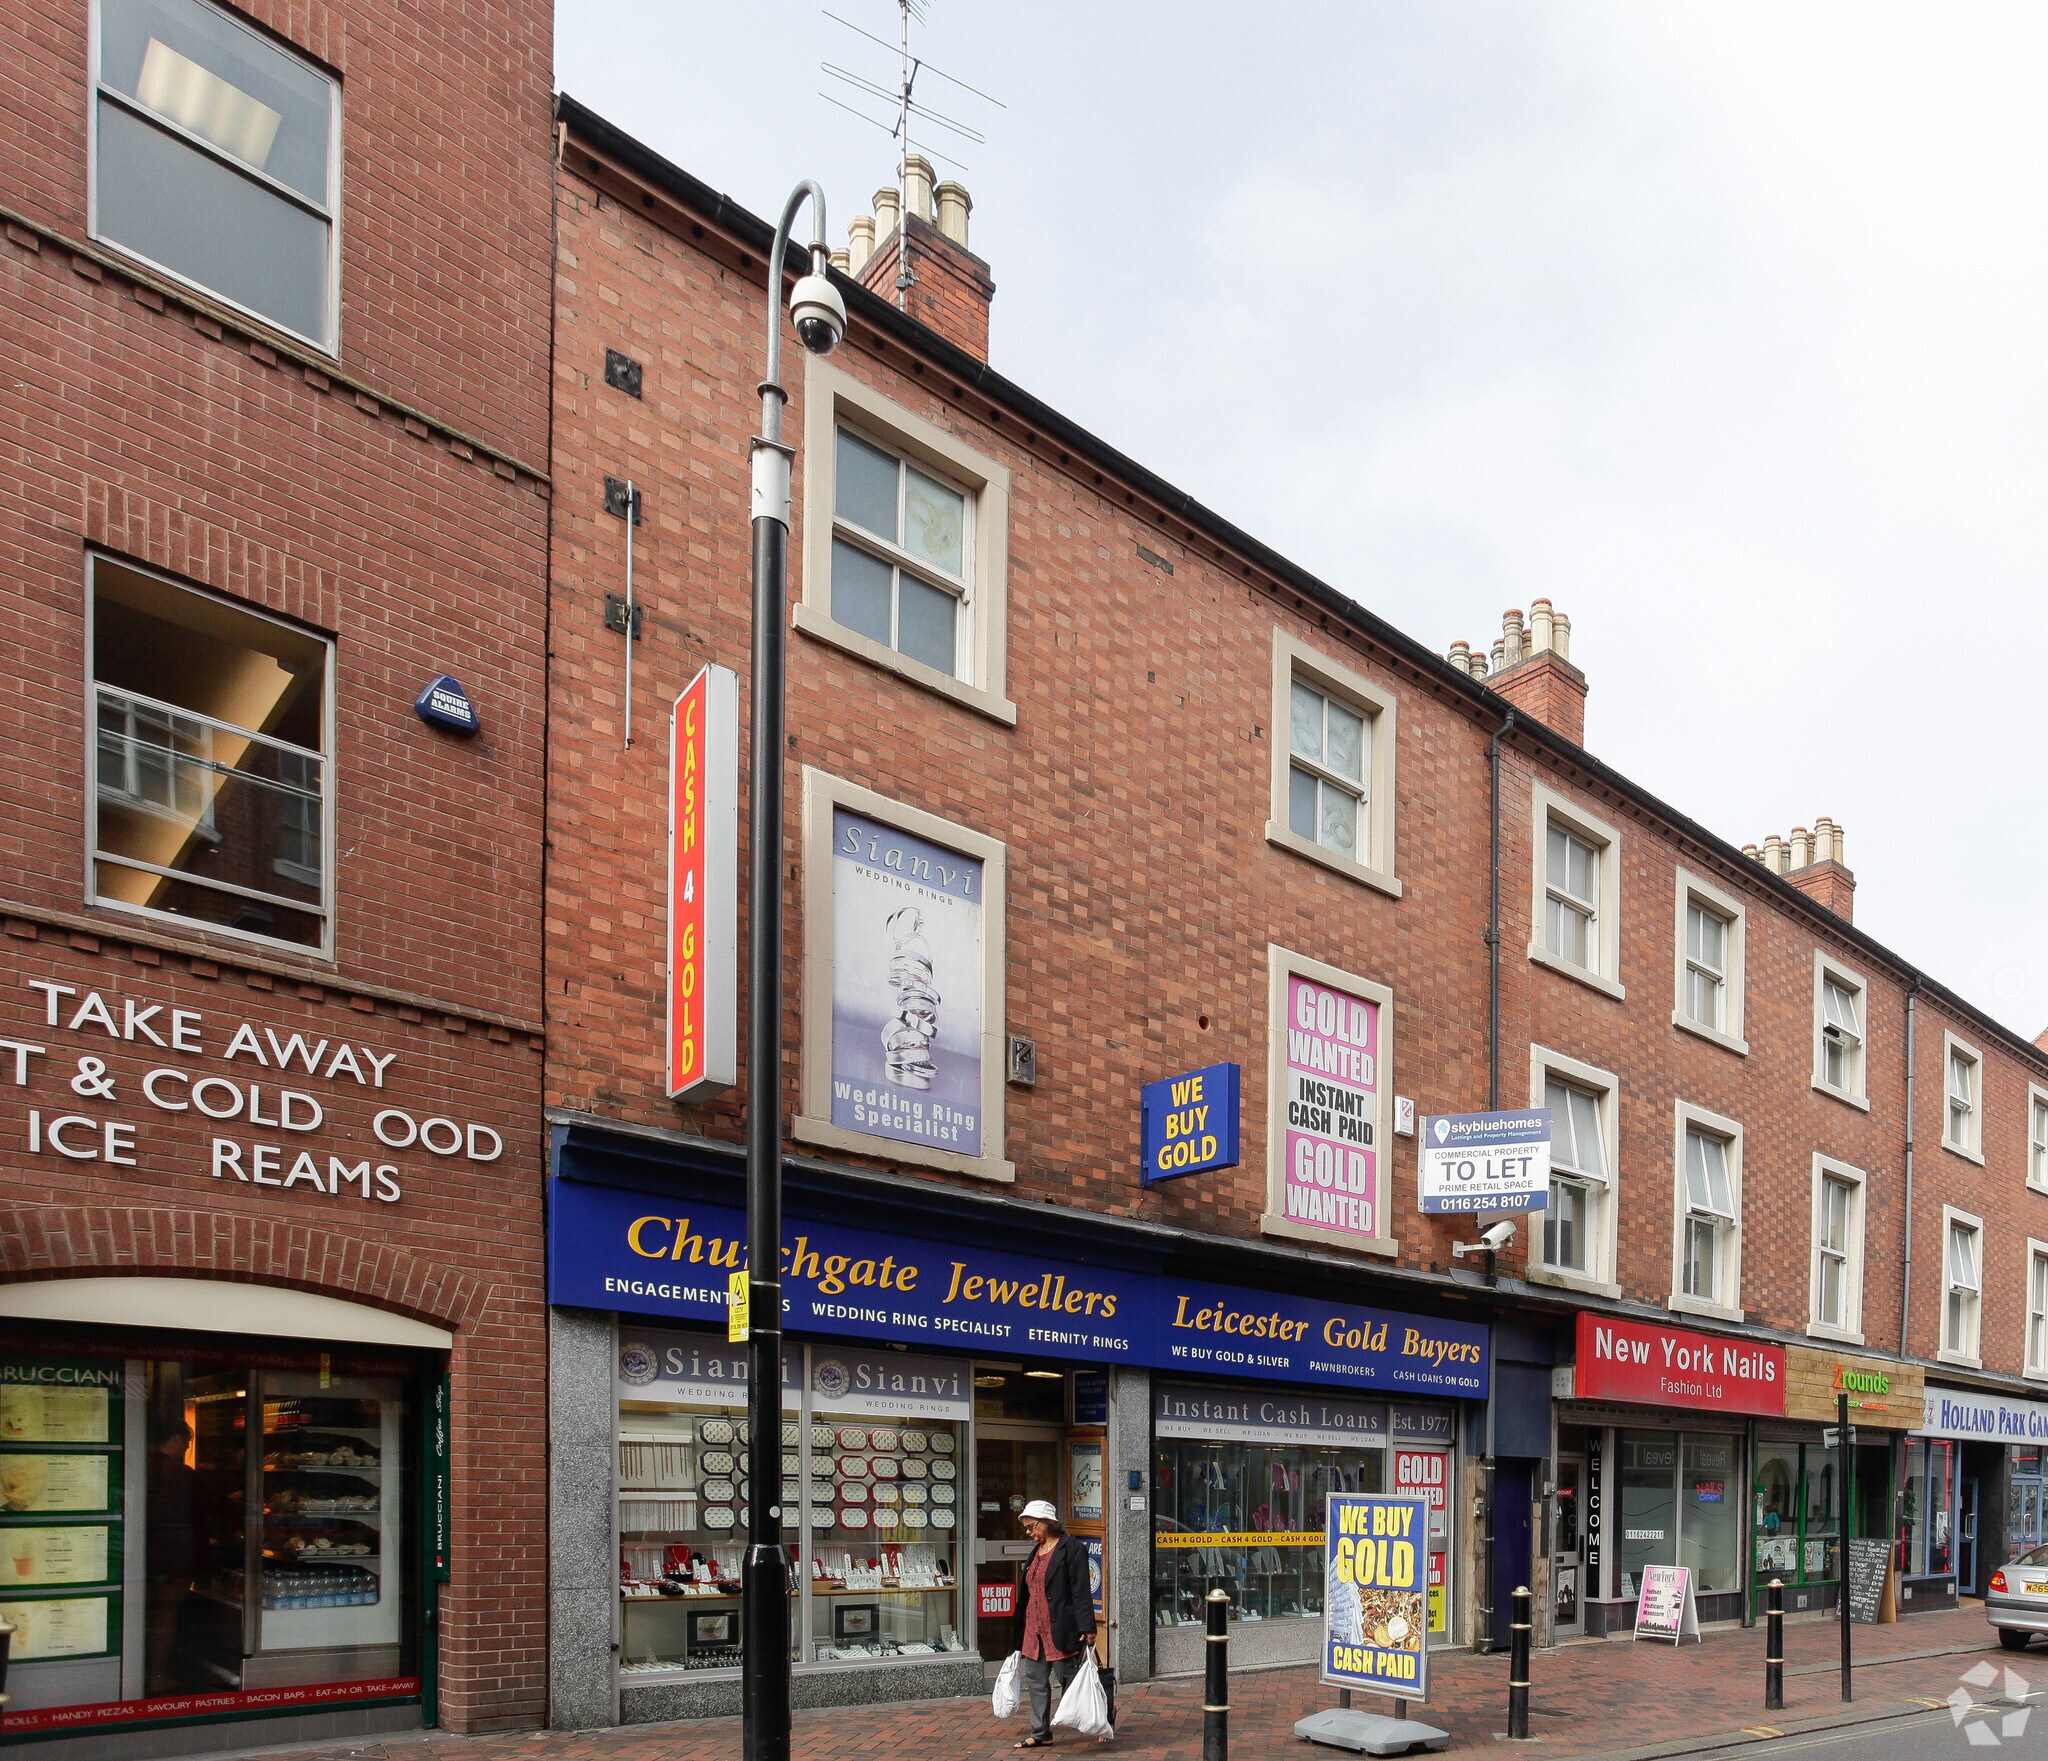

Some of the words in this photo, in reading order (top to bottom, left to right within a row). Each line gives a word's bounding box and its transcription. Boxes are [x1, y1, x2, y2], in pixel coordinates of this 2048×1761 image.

[431, 699, 471, 719] ALARMS
[432, 690, 469, 710] SQUIRE
[683, 698, 697, 854] CASH
[840, 825, 976, 897] Sianvi
[682, 870, 695, 904] 4
[854, 866, 912, 892] WEDDING
[918, 887, 954, 906] RINGS
[681, 923, 696, 1075] GOLD
[1296, 984, 1368, 1048] GOLD
[28, 980, 202, 1053] TAKE
[223, 1023, 397, 1087] AWAY
[1288, 1029, 1374, 1086] WANTED
[70, 1056, 117, 1100] &
[142, 1068, 323, 1131] COLD
[373, 1109, 503, 1161] OOD
[834, 1081, 924, 1119] Wedding
[932, 1102, 976, 1131] Ring
[1171, 1076, 1203, 1107] WE
[1299, 1077, 1364, 1117] INSTANT
[854, 1106, 958, 1142] Specialist
[1165, 1105, 1209, 1139] BUY
[1288, 1101, 1331, 1134] CASH
[1338, 1116, 1373, 1146] PAID
[1451, 1118, 1542, 1134] skybluehomes
[1484, 1132, 1506, 1141] Property
[1508, 1130, 1541, 1138] Management
[29, 1110, 137, 1165] ICE
[212, 1138, 401, 1203] REAMS
[1157, 1135, 1217, 1170] GOLD
[1294, 1137, 1366, 1195] GOLD
[1435, 1151, 1492, 1160] COMMERCIAL
[1494, 1146, 1540, 1155] PROPERTY
[1441, 1160, 1475, 1182] TO
[1486, 1157, 1532, 1180] LET
[1439, 1184, 1467, 1193] PRIME
[1470, 1182, 1501, 1191] RETAIL
[1504, 1180, 1533, 1189] SPACE
[1440, 1198, 1471, 1210] 0116
[1473, 1197, 1497, 1209] 254
[1501, 1195, 1531, 1208] 8107
[1287, 1184, 1373, 1231] WANTED
[627, 1216, 918, 1295] Chuhgate
[942, 1261, 1117, 1318] Jewellers
[812, 1302, 887, 1324] WEDDING
[892, 1312, 928, 1328] RING
[934, 1317, 1011, 1337] SPECIALIST
[1172, 1295, 1310, 1342] Leicester
[1323, 1317, 1389, 1352] Gold
[1401, 1327, 1481, 1368] Buyers
[1028, 1328, 1088, 1345] ETERNITY
[1093, 1336, 1129, 1350] RINGS
[1595, 1327, 1650, 1365] New
[1660, 1337, 1714, 1374] York
[1723, 1347, 1775, 1382] Nails
[665, 1347, 790, 1383] Siani
[1171, 1345, 1188, 1357] WE
[1191, 1347, 1213, 1360] BUY
[1215, 1350, 1244, 1363] GOLD
[1247, 1354, 1254, 1364] &
[1257, 1355, 1290, 1368] SILVER
[1309, 1360, 1375, 1377] PAWNBROKERS
[0, 1366, 119, 1385] RUCCIANI
[677, 1387, 735, 1398] WEDDING
[856, 1363, 960, 1396] Sianvi
[1393, 1370, 1415, 1381] CASH
[1417, 1373, 1443, 1384] LOANS
[1445, 1376, 1456, 1385] ON
[1458, 1377, 1479, 1388] GOLD
[1660, 1377, 1702, 1396] Fashion
[1706, 1382, 1722, 1399] Ltd
[435, 1385, 444, 1412] Shop
[865, 1400, 914, 1411] WEDDING
[919, 1404, 951, 1413] RINGS
[1162, 1394, 1249, 1421] Instant
[1260, 1402, 1311, 1425] Cash
[1321, 1407, 1378, 1430] Loans
[1393, 1412, 1416, 1430] Est.
[1420, 1414, 1449, 1433] 1977
[1941, 1399, 1994, 1433] HOLLAND
[1998, 1407, 2026, 1436] PARK
[435, 1418, 444, 1456] Coffee
[1398, 1455, 1443, 1484] GOLD
[1589, 1440, 1601, 1565] WELCOME
[1696, 1483, 1723, 1496] NAILS
[1340, 1505, 1368, 1535] WE
[1373, 1506, 1415, 1537] BUY
[1157, 1536, 1180, 1544] CASH
[1251, 1535, 1273, 1543] GOLD
[1280, 1535, 1300, 1543] CASH
[1337, 1538, 1415, 1588] GOLD
[981, 1587, 994, 1597] WE
[996, 1587, 1012, 1597] BUY
[982, 1598, 1011, 1612] GOLD
[1333, 1646, 1373, 1674] CASH
[1377, 1651, 1415, 1680] PAID
[4, 1715, 39, 1726] ROLLS
[52, 1710, 93, 1722] HANDY
[97, 1706, 134, 1717] PIZZAS
[147, 1700, 192, 1713] SAVOURY
[195, 1697, 235, 1708] PASTRIES
[247, 1693, 280, 1703] BACON
[284, 1690, 305, 1700] BAPS
[350, 1685, 362, 1694] OR
